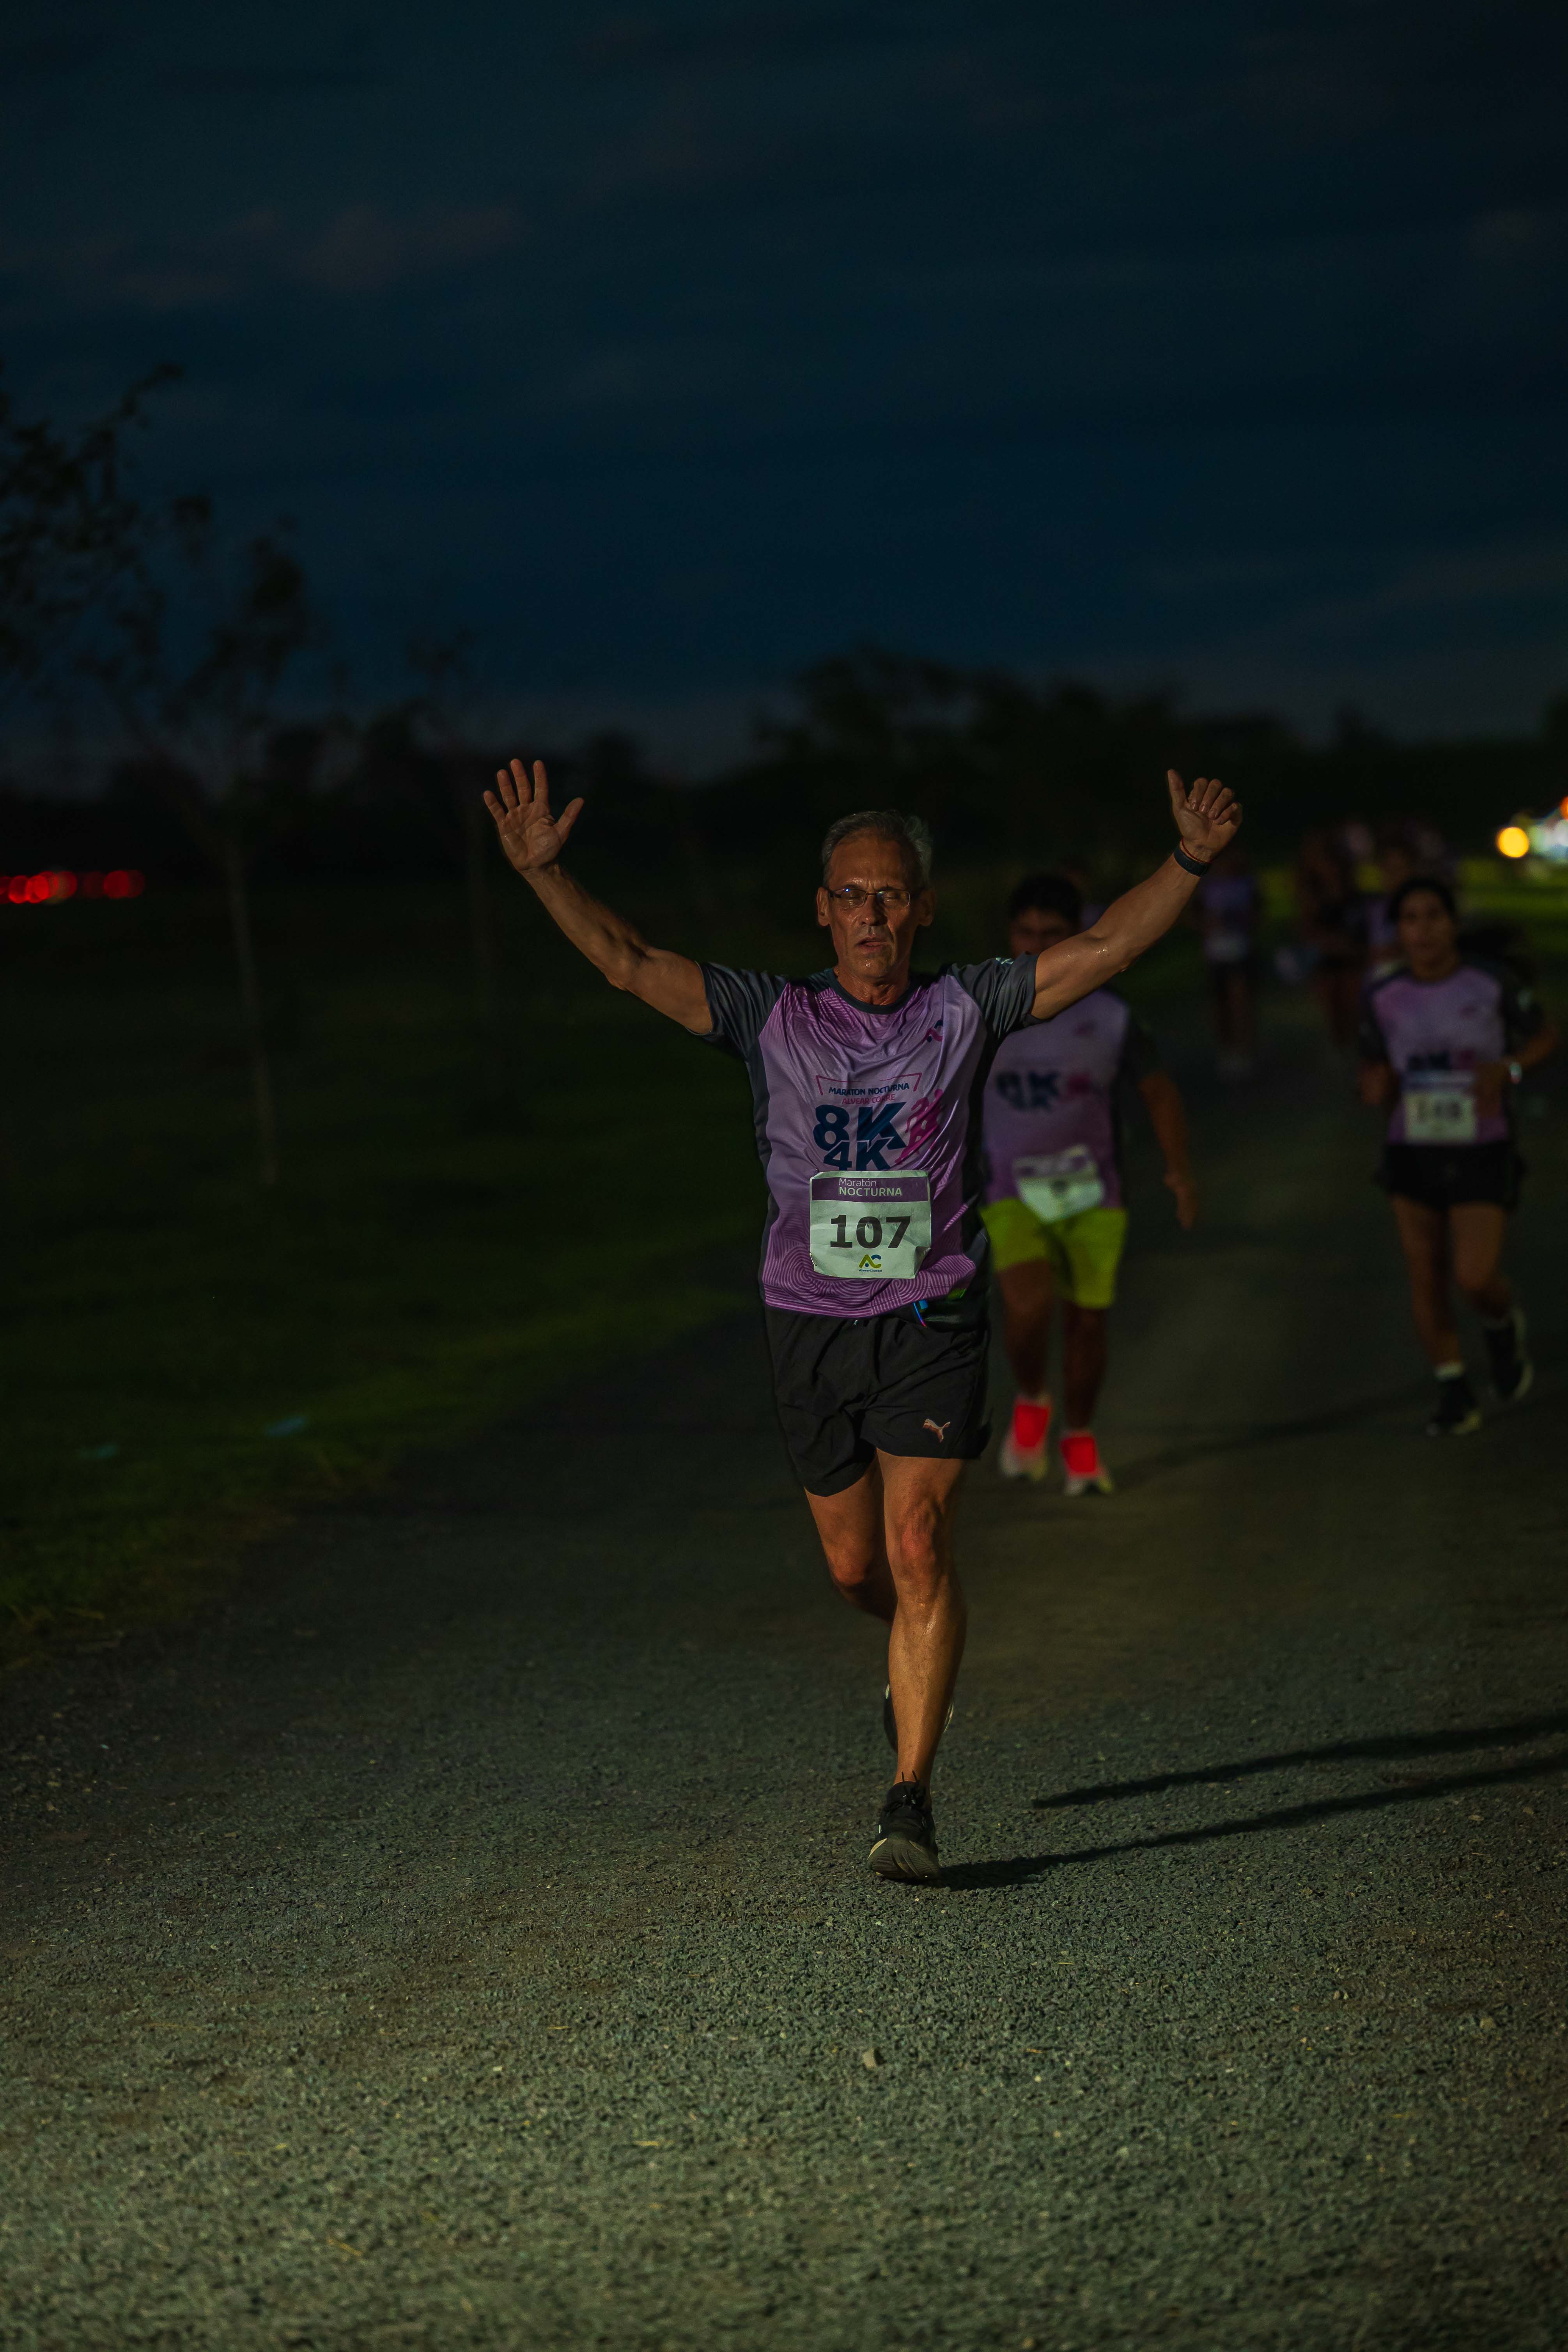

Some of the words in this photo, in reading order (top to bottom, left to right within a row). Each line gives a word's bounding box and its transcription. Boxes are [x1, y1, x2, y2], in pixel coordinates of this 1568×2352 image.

[829, 1087, 865, 1096] MARATON
[868, 1083, 909, 1095] NOCTURNA
[872, 1094, 895, 1103] CORRE
[813, 1102, 907, 1151] 8K
[823, 1137, 892, 1171] 4K
[839, 1178, 876, 1187] Maratón
[839, 1187, 902, 1196] NOCTURNA
[830, 1215, 911, 1249] 107
